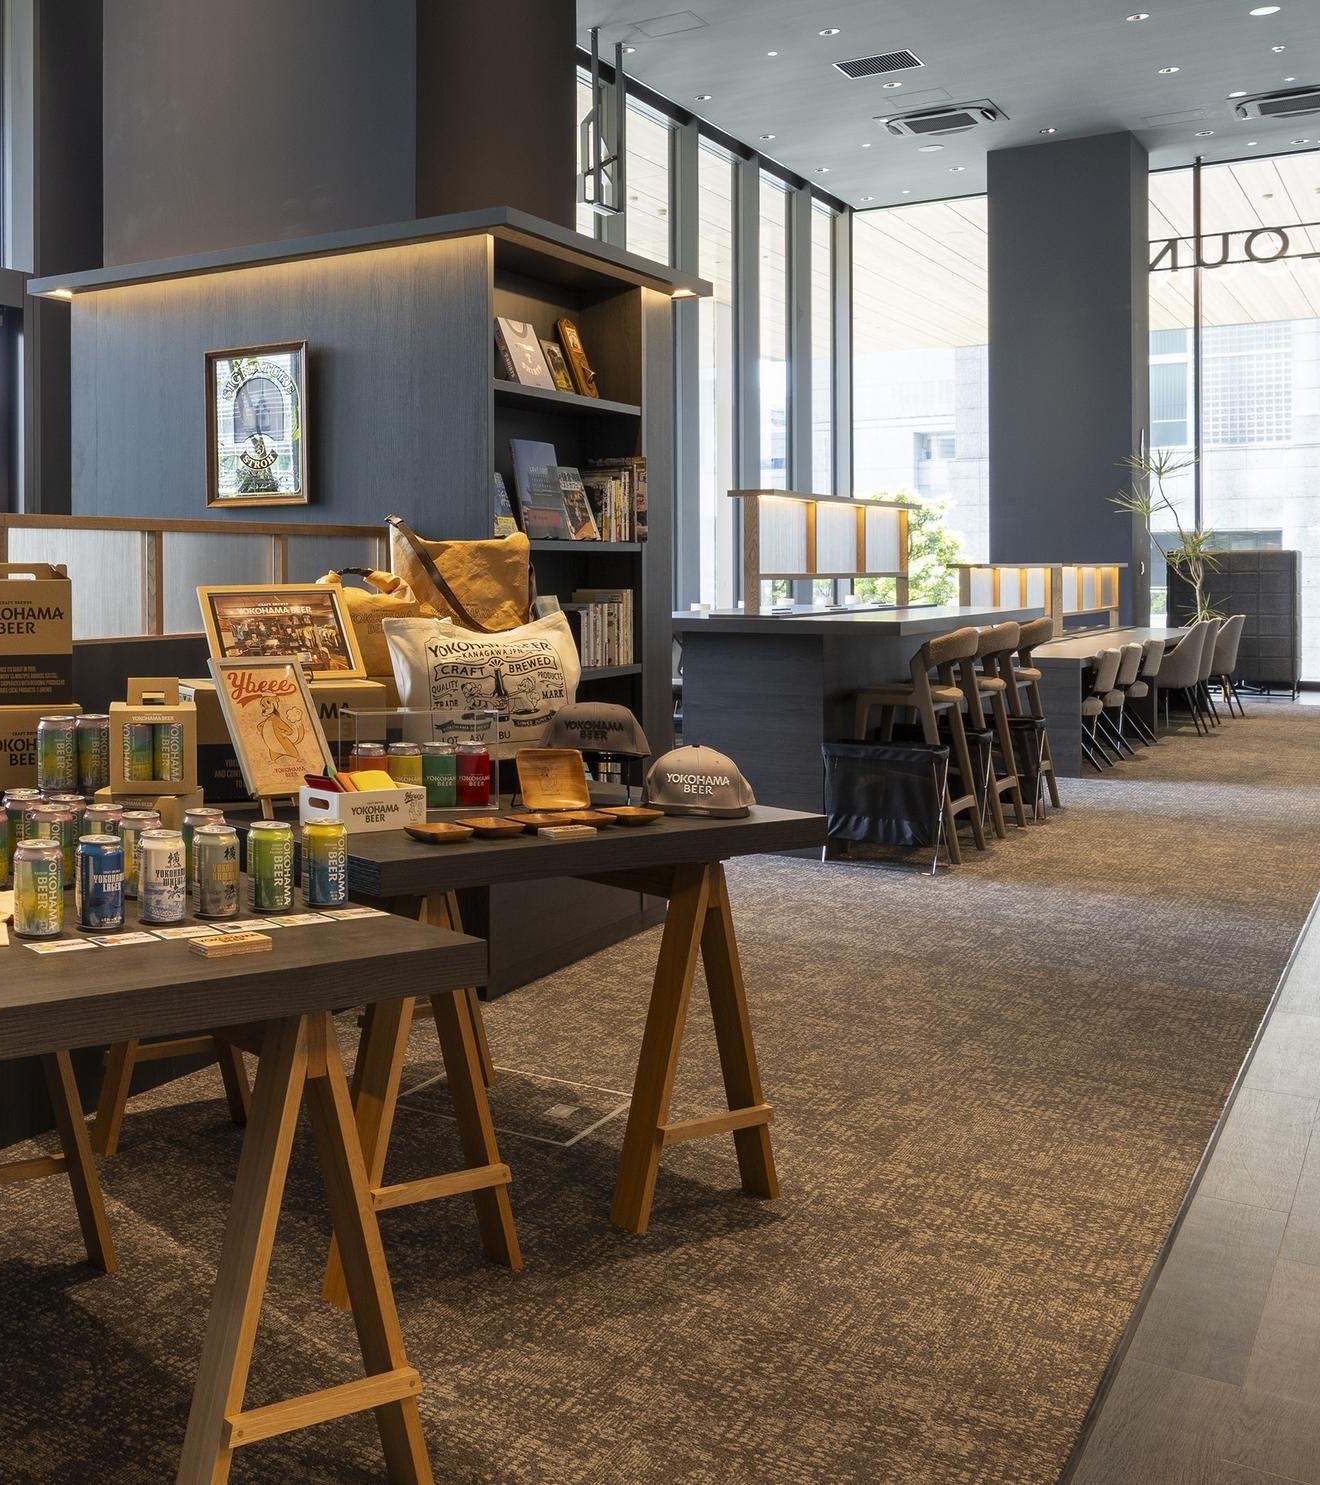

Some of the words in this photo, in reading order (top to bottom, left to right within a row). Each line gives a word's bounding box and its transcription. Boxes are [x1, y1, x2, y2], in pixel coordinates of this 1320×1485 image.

[222, 361, 296, 400] SIGNATURE
[243, 453, 274, 469] STROH
[237, 607, 290, 615] YOKOHAMA
[290, 606, 312, 614] BEER
[462, 649, 507, 658] KANAGAWA
[441, 665, 486, 676] CRAFT
[508, 657, 551, 673] BREWED
[537, 671, 563, 681] PRODUCTS
[432, 680, 459, 694] QUALITY
[541, 689, 565, 699] MARK
[564, 719, 624, 732] YOKOHAMA
[498, 731, 511, 740] BU
[579, 730, 608, 741] BEER
[56, 742, 65, 769] BEER
[91, 741, 100, 767] BEER
[162, 738, 170, 766] BEER
[9, 753, 37, 766] BEE
[274, 766, 306, 774] YOKOHAMA
[666, 773, 730, 786] YOKOHAMA
[683, 784, 714, 795] BEER
[351, 804, 399, 816] YOKOHAMA
[365, 814, 386, 823] BEER
[328, 851, 337, 882] BEER
[337, 826, 346, 901] YOKOHAMA
[274, 855, 284, 887] BEER
[37, 876, 48, 910] BEER
[48, 855, 58, 930] YOKOHAMA
